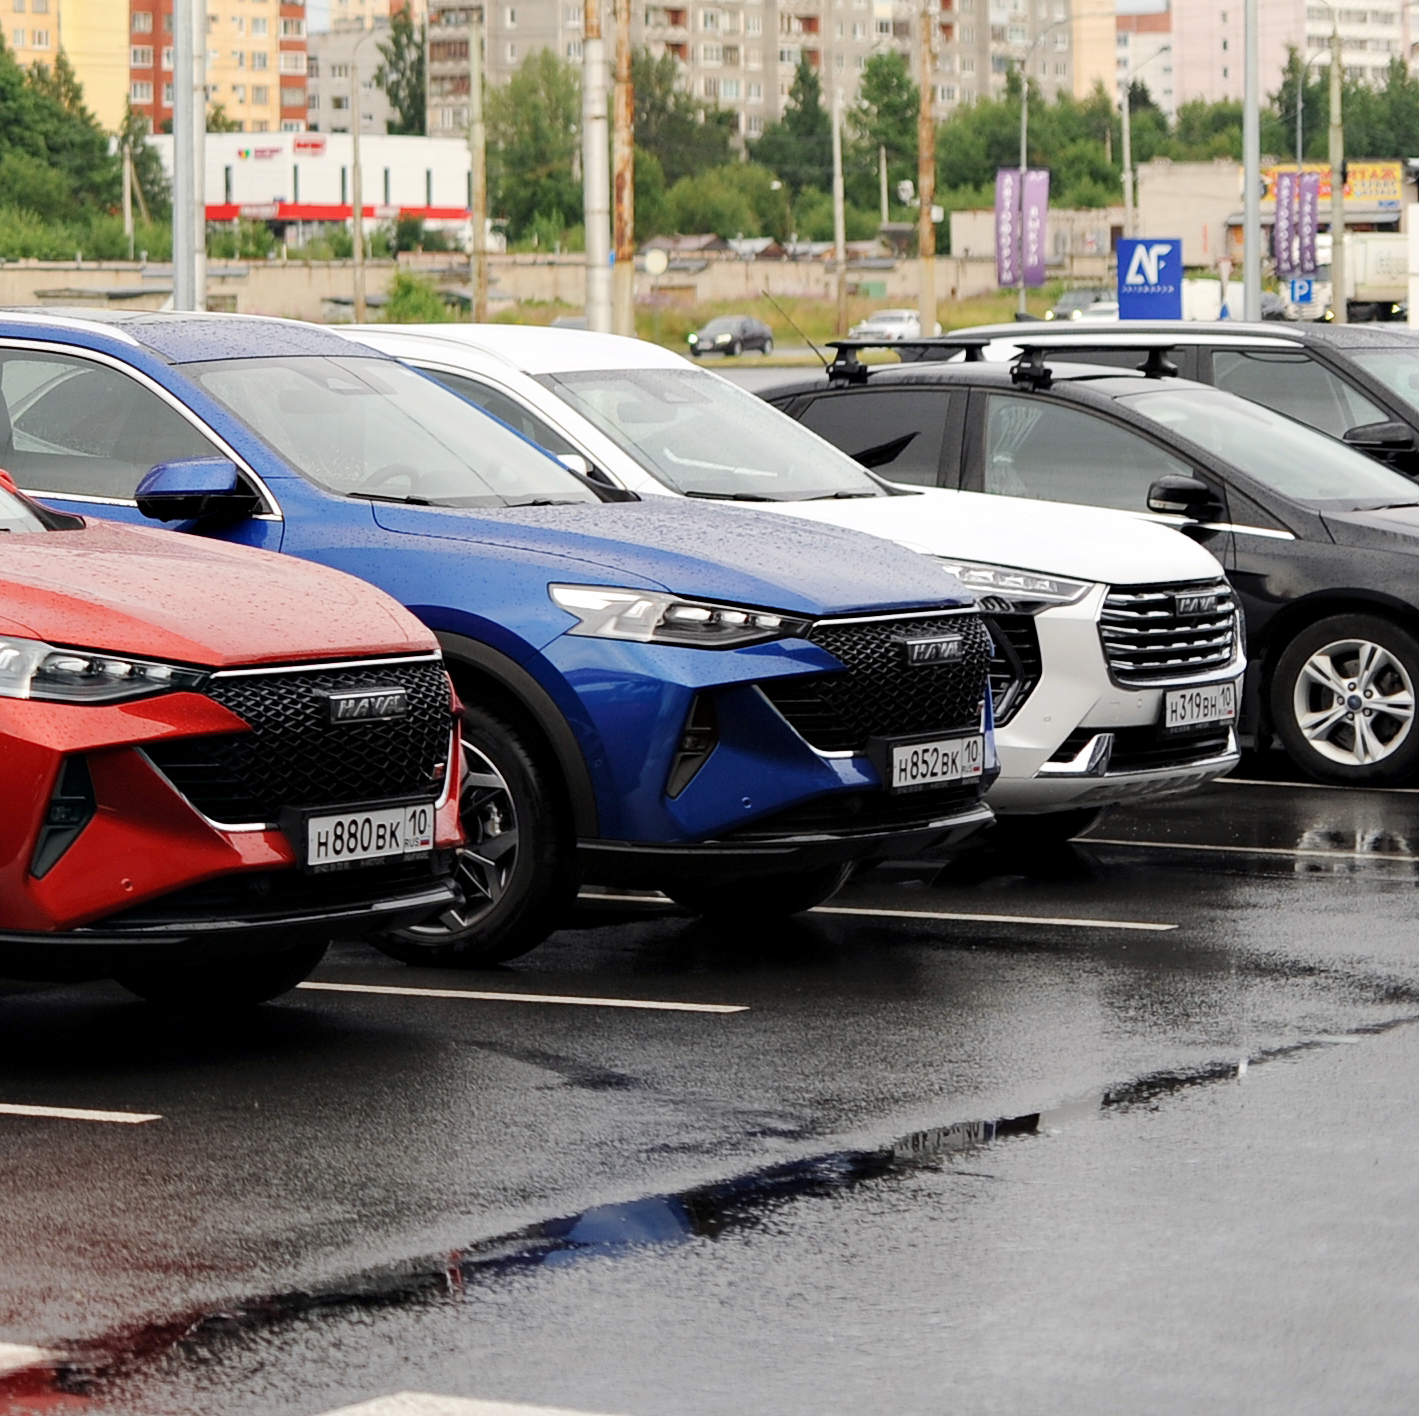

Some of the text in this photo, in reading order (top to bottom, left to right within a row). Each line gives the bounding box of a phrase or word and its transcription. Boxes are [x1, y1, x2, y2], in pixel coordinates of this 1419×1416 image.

[1125, 244, 1173, 286] AF
[1294, 280, 1309, 303] P
[338, 695, 405, 718] HAVAL
[964, 740, 978, 763] 10
[408, 809, 427, 836] 10
[404, 837, 420, 848] RUS
